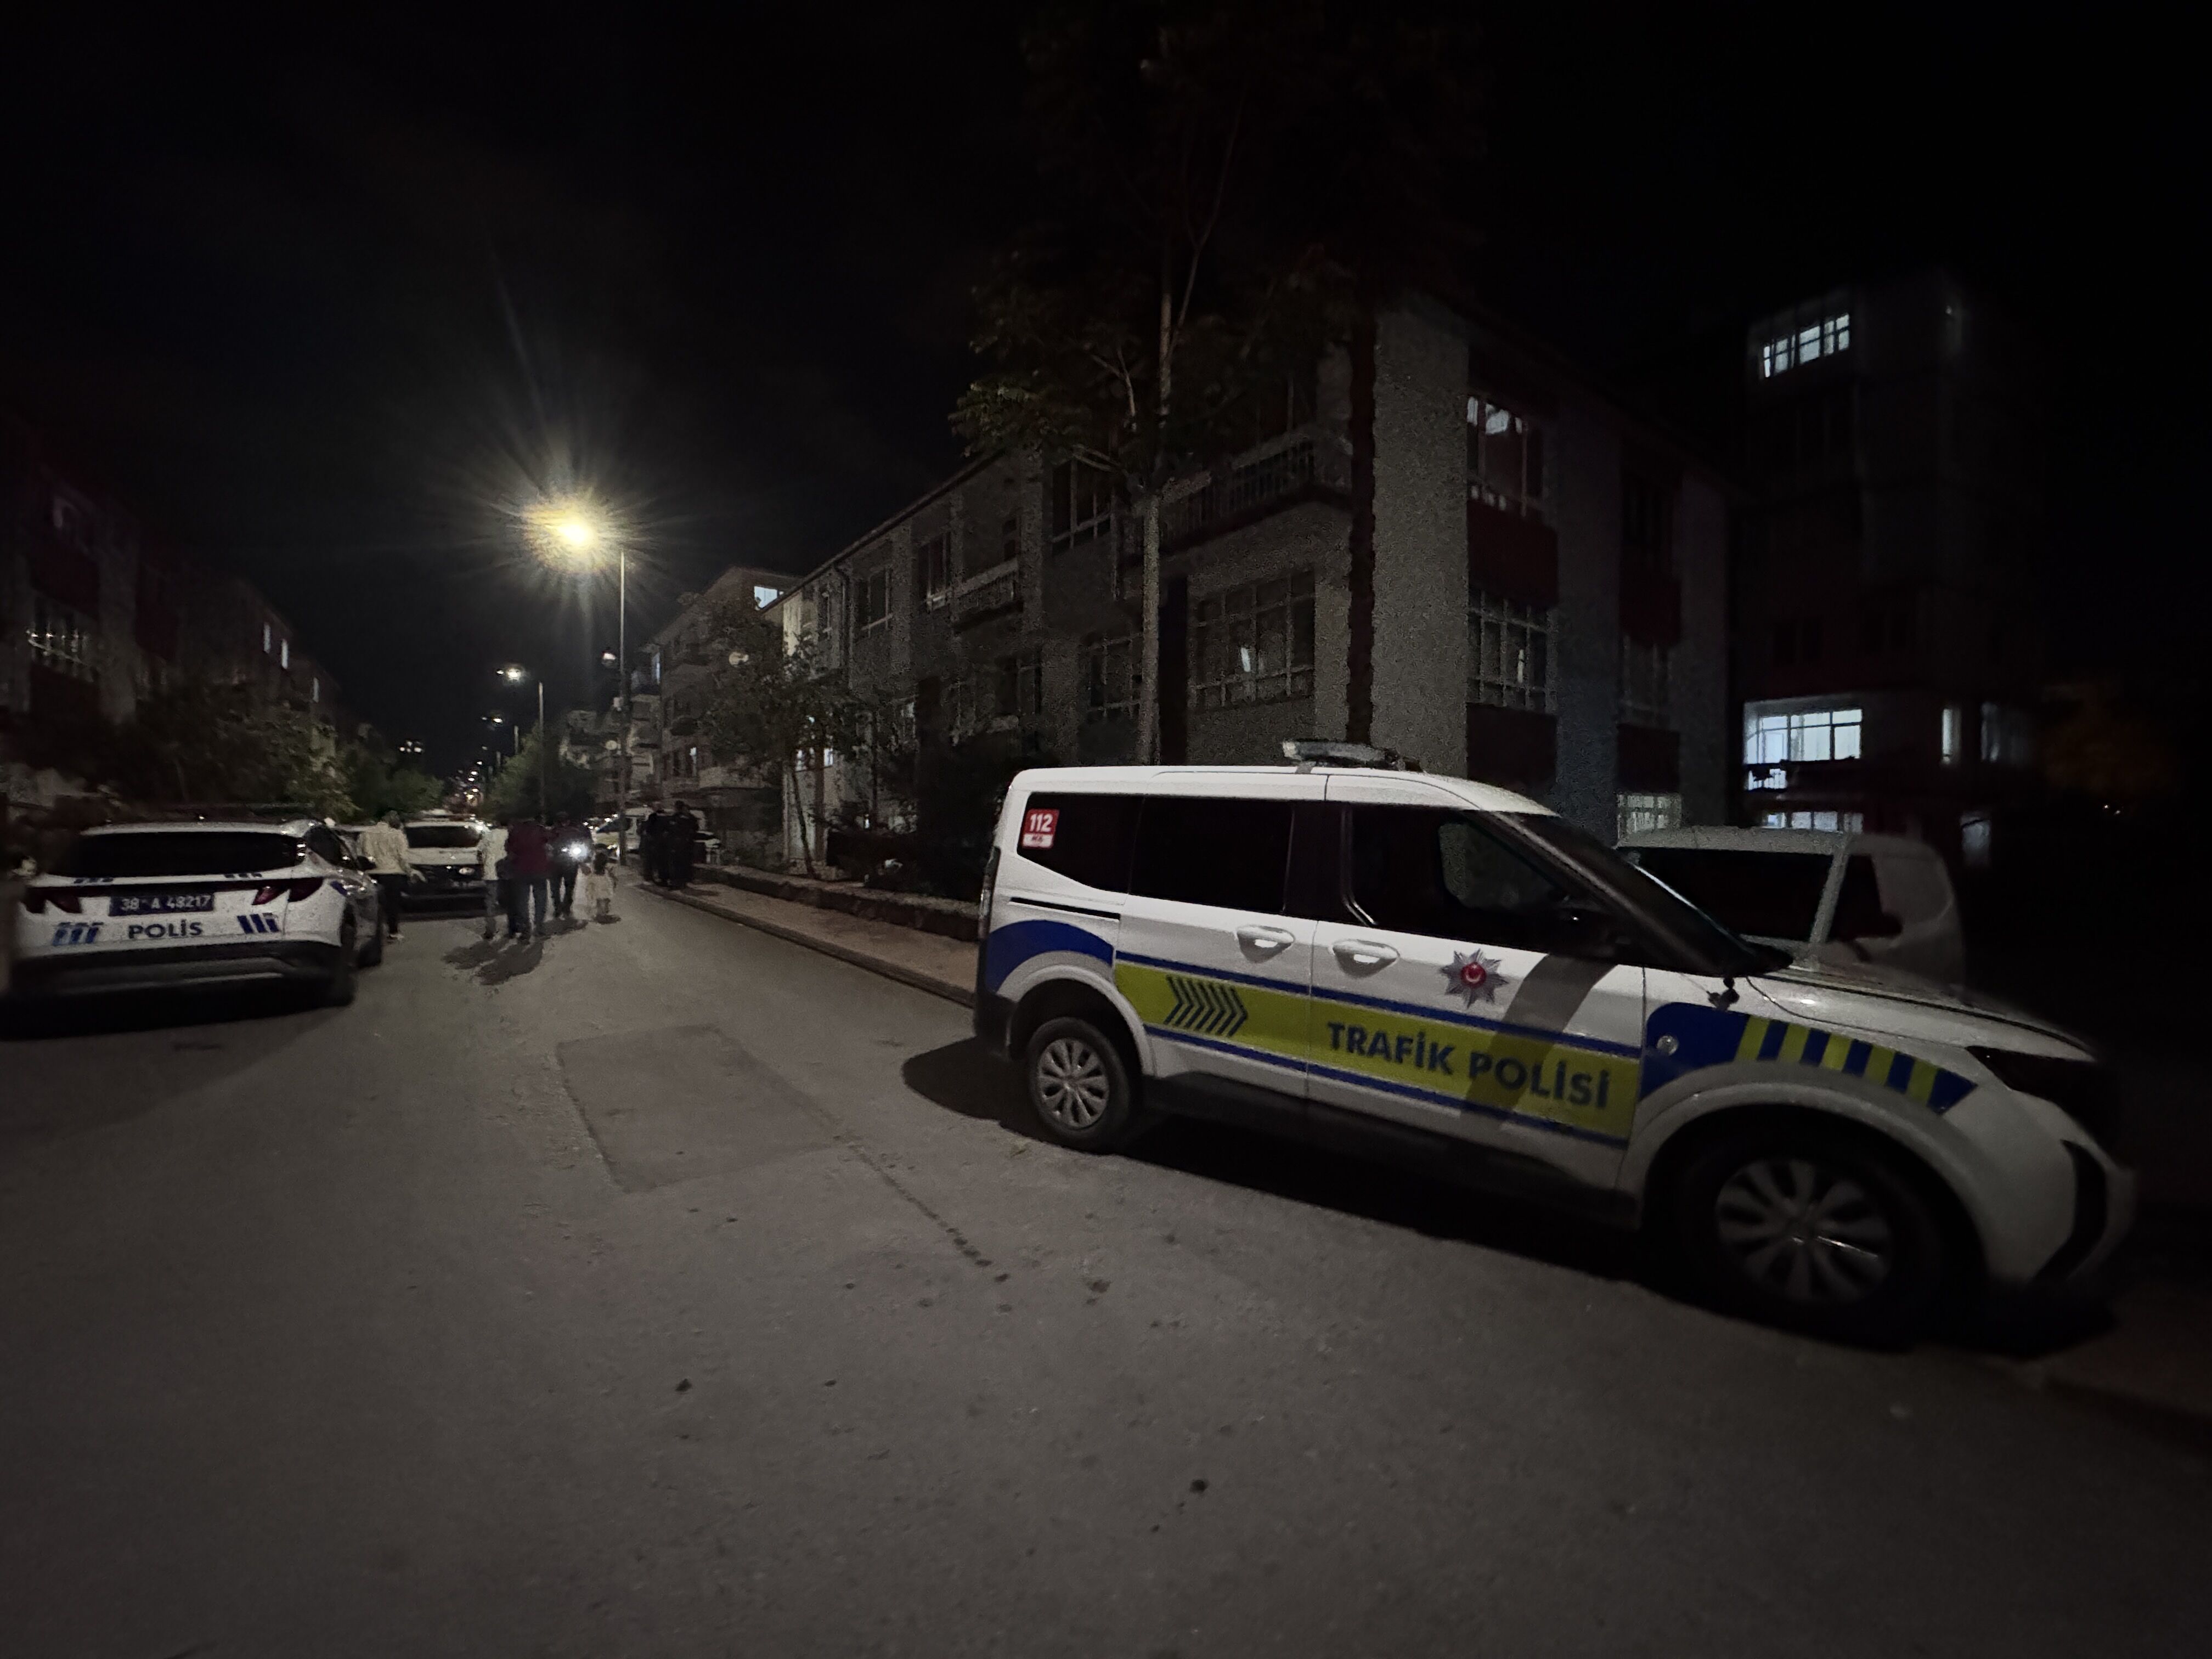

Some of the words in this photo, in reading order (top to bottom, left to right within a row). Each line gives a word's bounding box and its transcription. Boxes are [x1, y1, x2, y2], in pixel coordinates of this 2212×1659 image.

[1029, 813, 1053, 832] 112
[121, 897, 139, 911] 38
[151, 897, 161, 909] A
[128, 919, 202, 939] POLİS
[1327, 1022, 1455, 1075] TRAFİK
[1469, 1051, 1610, 1109] POLİSİ
